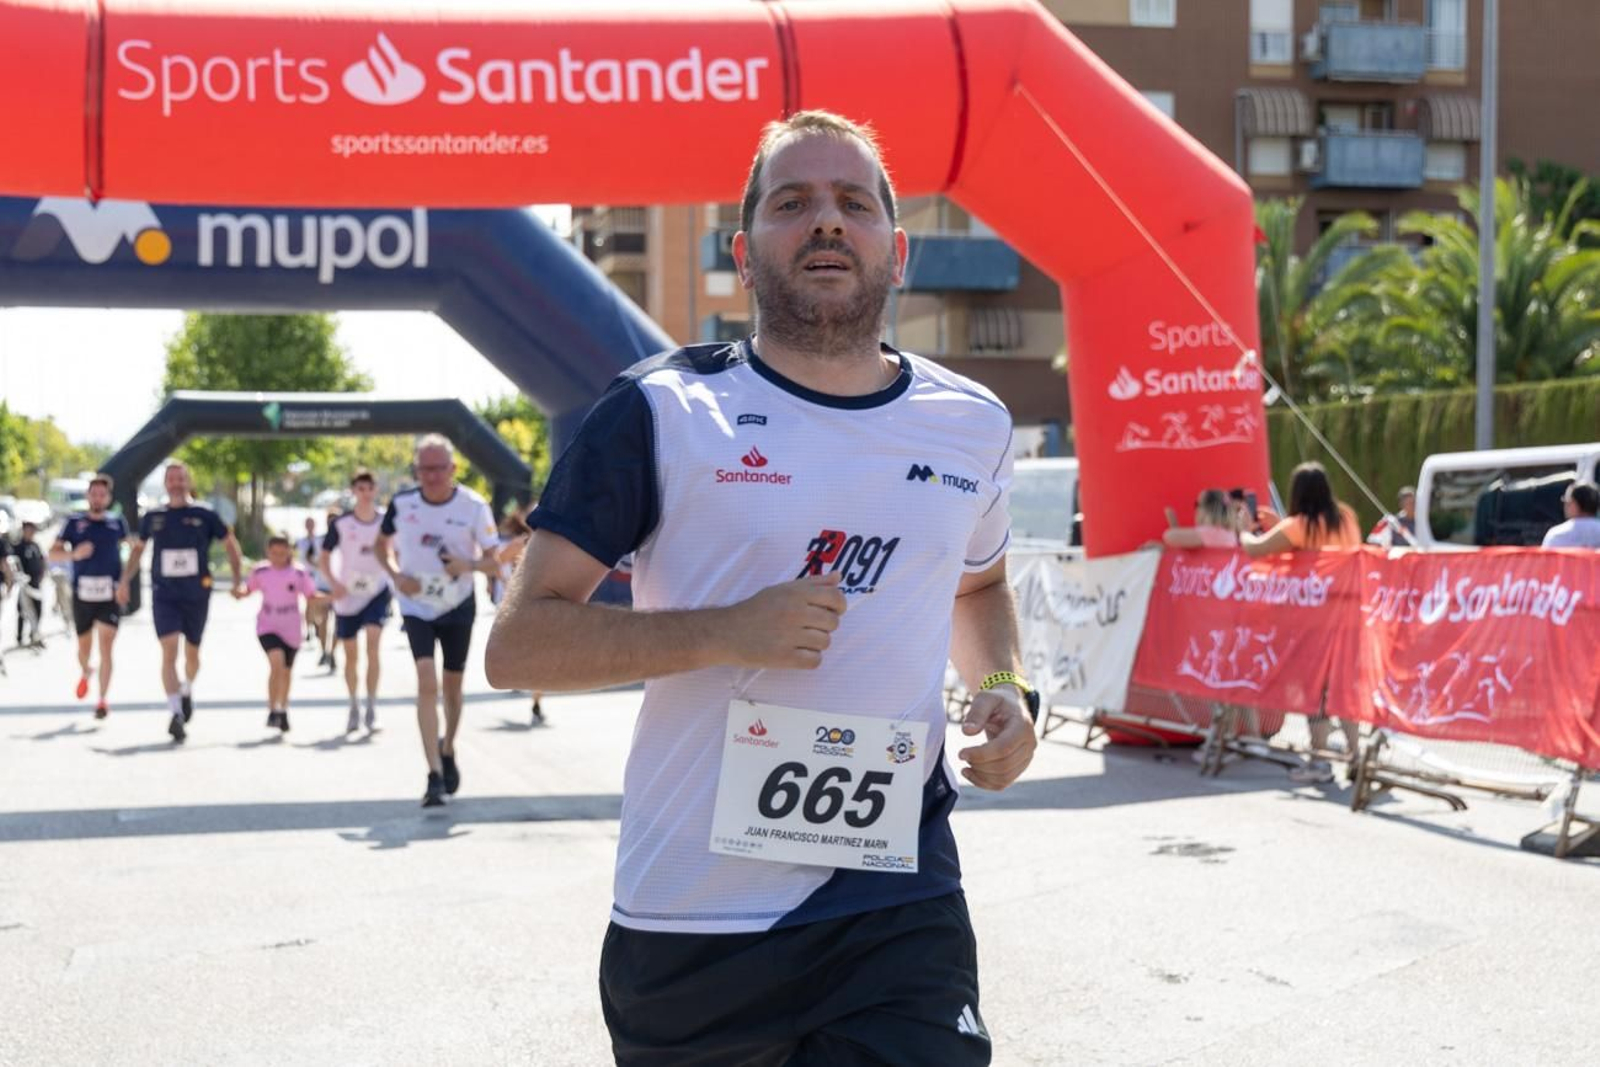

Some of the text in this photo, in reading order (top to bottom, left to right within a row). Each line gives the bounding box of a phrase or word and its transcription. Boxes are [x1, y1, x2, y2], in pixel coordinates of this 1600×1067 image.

[117, 39, 769, 116] Sports Santander
[330, 132, 549, 157] sportssantander.es
[198, 206, 428, 283] mupol
[1148, 320, 1236, 355] Sports
[716, 469, 792, 484] Santander
[941, 472, 979, 494] mupol
[1233, 564, 1334, 606] Santander
[1448, 572, 1583, 625] Santander
[733, 734, 780, 748] Santander
[815, 726, 856, 745] 200
[758, 761, 894, 828] 665
[744, 826, 889, 849] JUAN FRANCISCO MARTINEZ MARIN
[862, 861, 915, 870] NACIONAL
[863, 854, 904, 863] POLICIA
